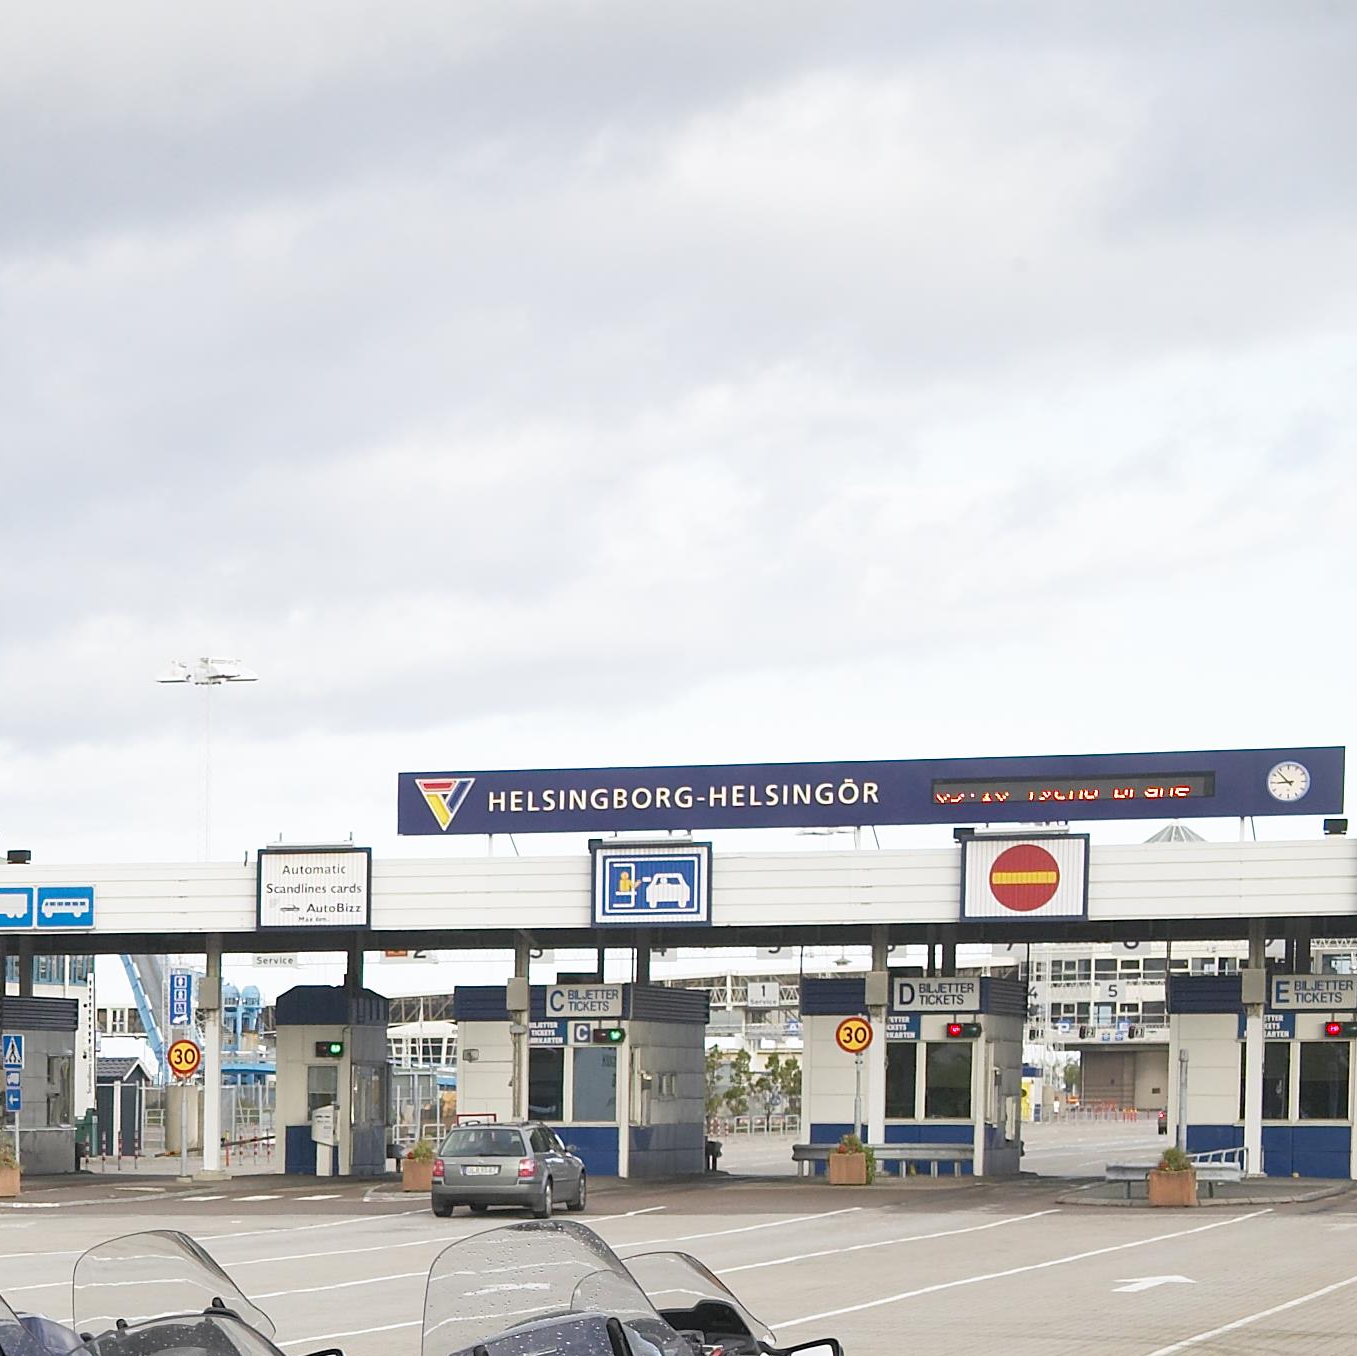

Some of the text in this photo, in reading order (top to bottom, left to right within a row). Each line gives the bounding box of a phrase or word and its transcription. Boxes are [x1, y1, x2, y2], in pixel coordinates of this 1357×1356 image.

[488, 778, 880, 813] HELSINGBORG-HELSINGÖR
[282, 864, 347, 875] Automatic
[266, 883, 362, 894] Scandlines cards
[306, 903, 361, 912] AutoBizz
[256, 956, 294, 965] Service
[762, 984, 766, 997] 1
[918, 983, 974, 993] BILJETTER
[1108, 985, 1118, 997] 5
[1294, 980, 1353, 991] BILJETTER
[567, 989, 619, 1000] BILJETTER
[899, 983, 915, 1005] D
[1276, 981, 1290, 1003] E
[1295, 992, 1342, 1003] TICKETS
[550, 990, 564, 1012] C
[918, 994, 964, 1005] TICKETS
[568, 1001, 610, 1011] TICKETS
[576, 1025, 588, 1041] C
[843, 1027, 867, 1044] 30
[174, 1049, 196, 1065] 30
